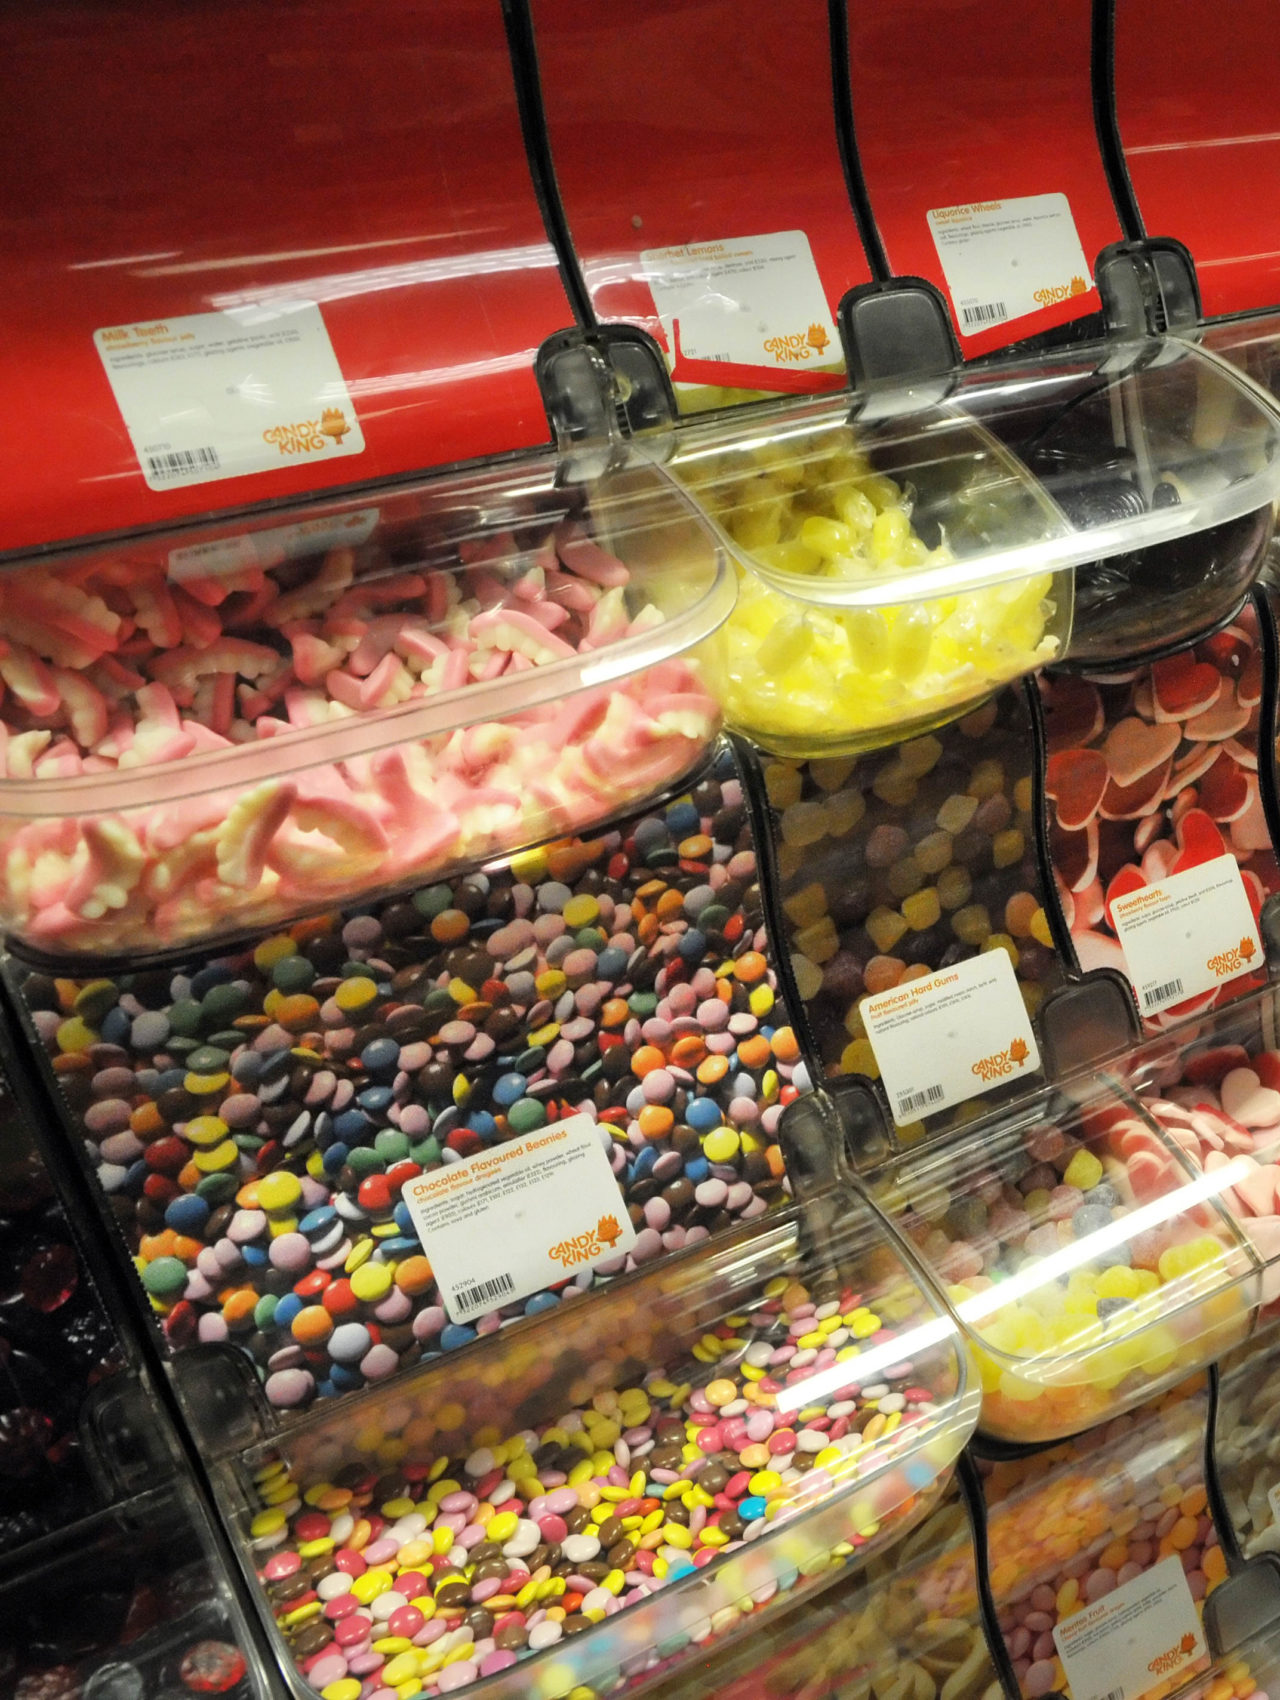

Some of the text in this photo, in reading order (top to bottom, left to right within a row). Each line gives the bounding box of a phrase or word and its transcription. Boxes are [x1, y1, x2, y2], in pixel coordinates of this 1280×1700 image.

[932, 201, 1002, 219] Liquorice Wheels
[686, 243, 724, 255] Lemons
[1033, 285, 1069, 302] CANDY
[102, 329, 128, 341] Milk
[763, 333, 805, 352] CANDY
[775, 346, 810, 362] KING
[262, 420, 321, 444] CANDY
[278, 434, 325, 455] KING
[1117, 889, 1162, 912] Sweethearts
[1207, 948, 1239, 970] CANDY
[1215, 958, 1241, 977] KING
[868, 973, 959, 1013] American Hard Gums
[971, 1050, 1009, 1075] CANDY
[981, 1062, 1012, 1082] KING
[413, 1130, 567, 1197] Chocolate Flavoured Beanies
[417, 1188, 449, 1204] chocolate
[451, 1178, 473, 1191] flavour
[465, 1178, 500, 1196] hydrogenated
[500, 1169, 523, 1182] vegetable
[548, 1229, 596, 1260] CANDY
[561, 1242, 600, 1268] KING
[1060, 1605, 1106, 1637] Mentos Fruit
[1147, 1645, 1180, 1672] CANDY
[1156, 1656, 1182, 1676] KING
